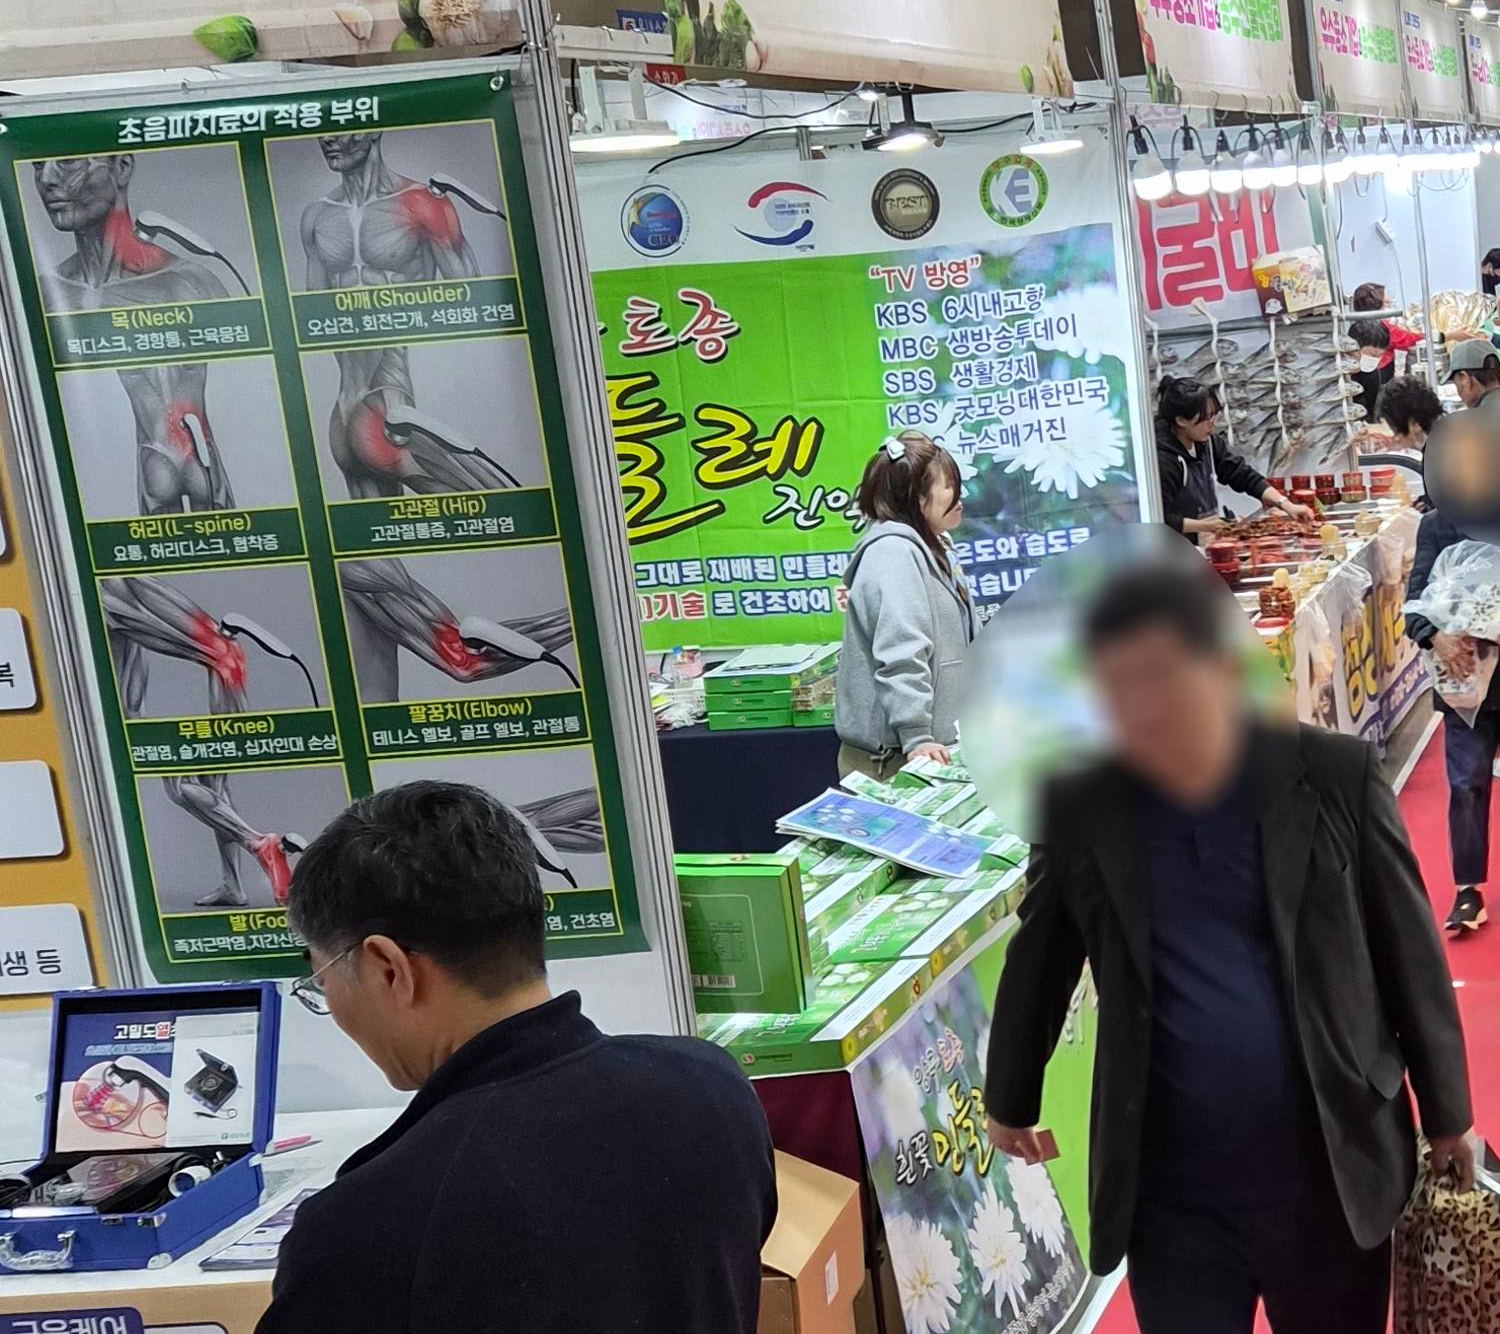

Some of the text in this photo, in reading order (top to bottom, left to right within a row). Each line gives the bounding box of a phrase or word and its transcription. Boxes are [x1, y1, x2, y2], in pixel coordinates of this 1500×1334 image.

[118, 96, 379, 144] 초음파치료의 적용 부위
[335, 283, 471, 311] 어깨(Shoulder)
[876, 285, 1045, 327] KBS 6시내고향
[111, 307, 194, 330] 목(Neck)
[620, 290, 739, 362] 토종
[880, 313, 1077, 361] MBC 생방송투데이
[885, 354, 1036, 394] SBS 생활경제
[889, 378, 1107, 427] KBS 굿모닝대한민국
[957, 416, 1067, 455] 뉴스매거진
[388, 496, 487, 520] 고관절(Hip)
[129, 513, 252, 540] 허리(L-spine)
[954, 535, 1019, 565] 온도와
[636, 558, 704, 588] 그대로
[707, 555, 778, 584] 재배된
[712, 591, 737, 616] 로
[740, 586, 831, 616] 건조하여
[407, 698, 533, 724] 팔꿈치(Elbow)
[229, 913, 288, 932] 발(Foo
[544, 915, 568, 931] 염,
[0, 948, 62, 977] 생 등
